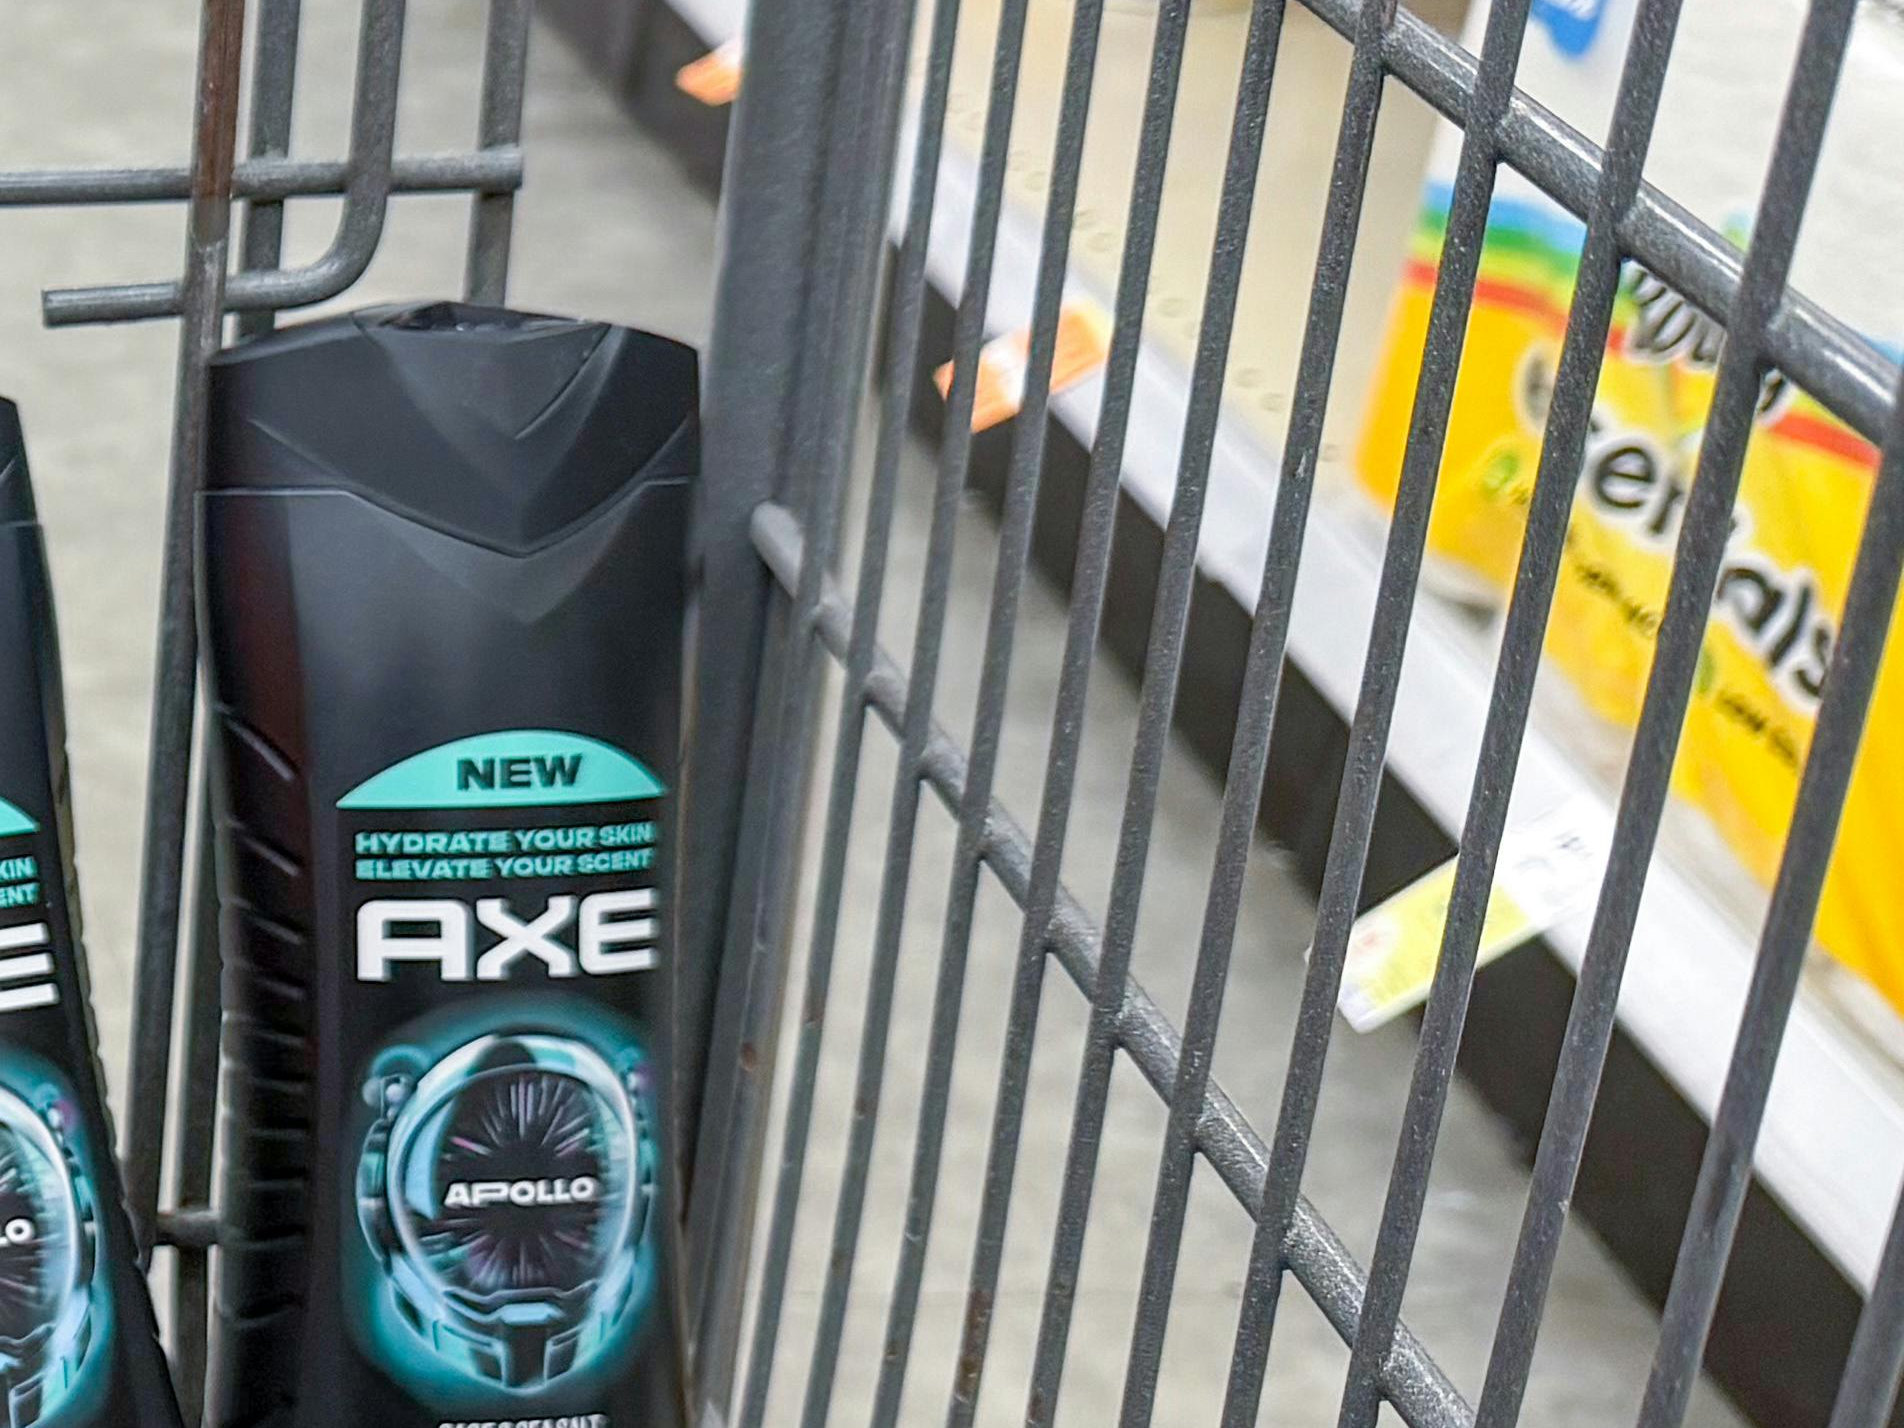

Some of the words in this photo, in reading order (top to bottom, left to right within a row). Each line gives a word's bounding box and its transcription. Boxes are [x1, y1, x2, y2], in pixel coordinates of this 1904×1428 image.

[456, 753, 583, 791] NEW
[354, 830, 511, 855] HYDRATE
[514, 826, 595, 850] YOUR
[598, 821, 655, 846] SKIN
[355, 857, 492, 880] ELEVATE
[494, 854, 576, 878] YOUR
[577, 847, 654, 872] SCENT
[356, 887, 660, 982] AXE
[445, 1176, 598, 1208] APOLLO
